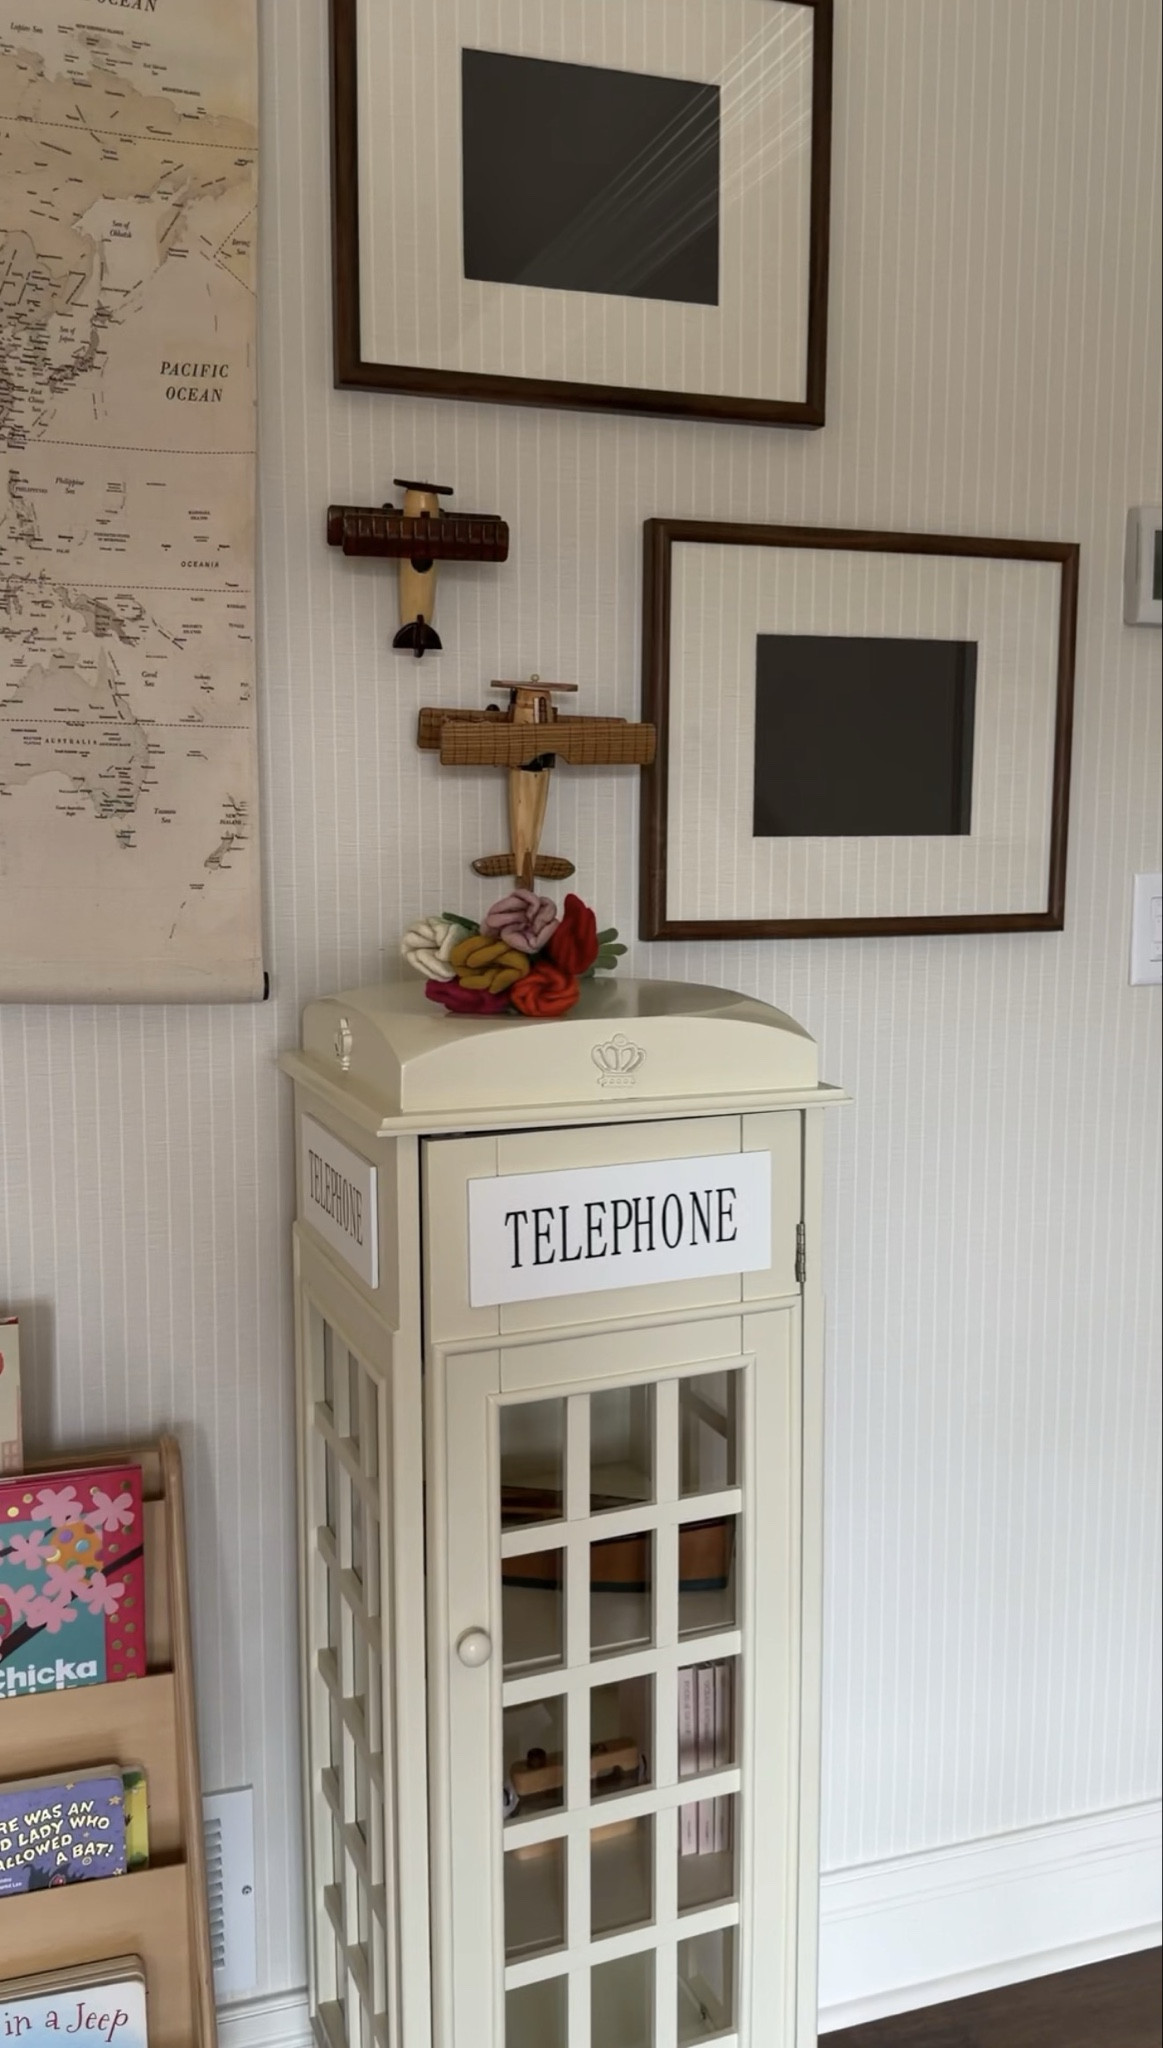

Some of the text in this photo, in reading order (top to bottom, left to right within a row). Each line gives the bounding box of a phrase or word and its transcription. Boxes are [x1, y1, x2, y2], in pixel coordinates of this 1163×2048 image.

[160, 361, 229, 378] PACIFIC
[165, 385, 223, 402] OCEAN
[180, 560, 220, 569] OCEANIA
[45, 738, 98, 746] AUSTRALIA
[308, 1148, 363, 1246] TELEPHONE
[504, 1187, 738, 1269] TELEPHONE
[24, 1803, 63, 1827] WAS
[68, 1800, 95, 1816] AN
[18, 1819, 64, 1847] LADY
[69, 1815, 110, 1831] WHO
[56, 1841, 114, 1868] A BAT!
[4, 2002, 129, 2043] in a Jeep
